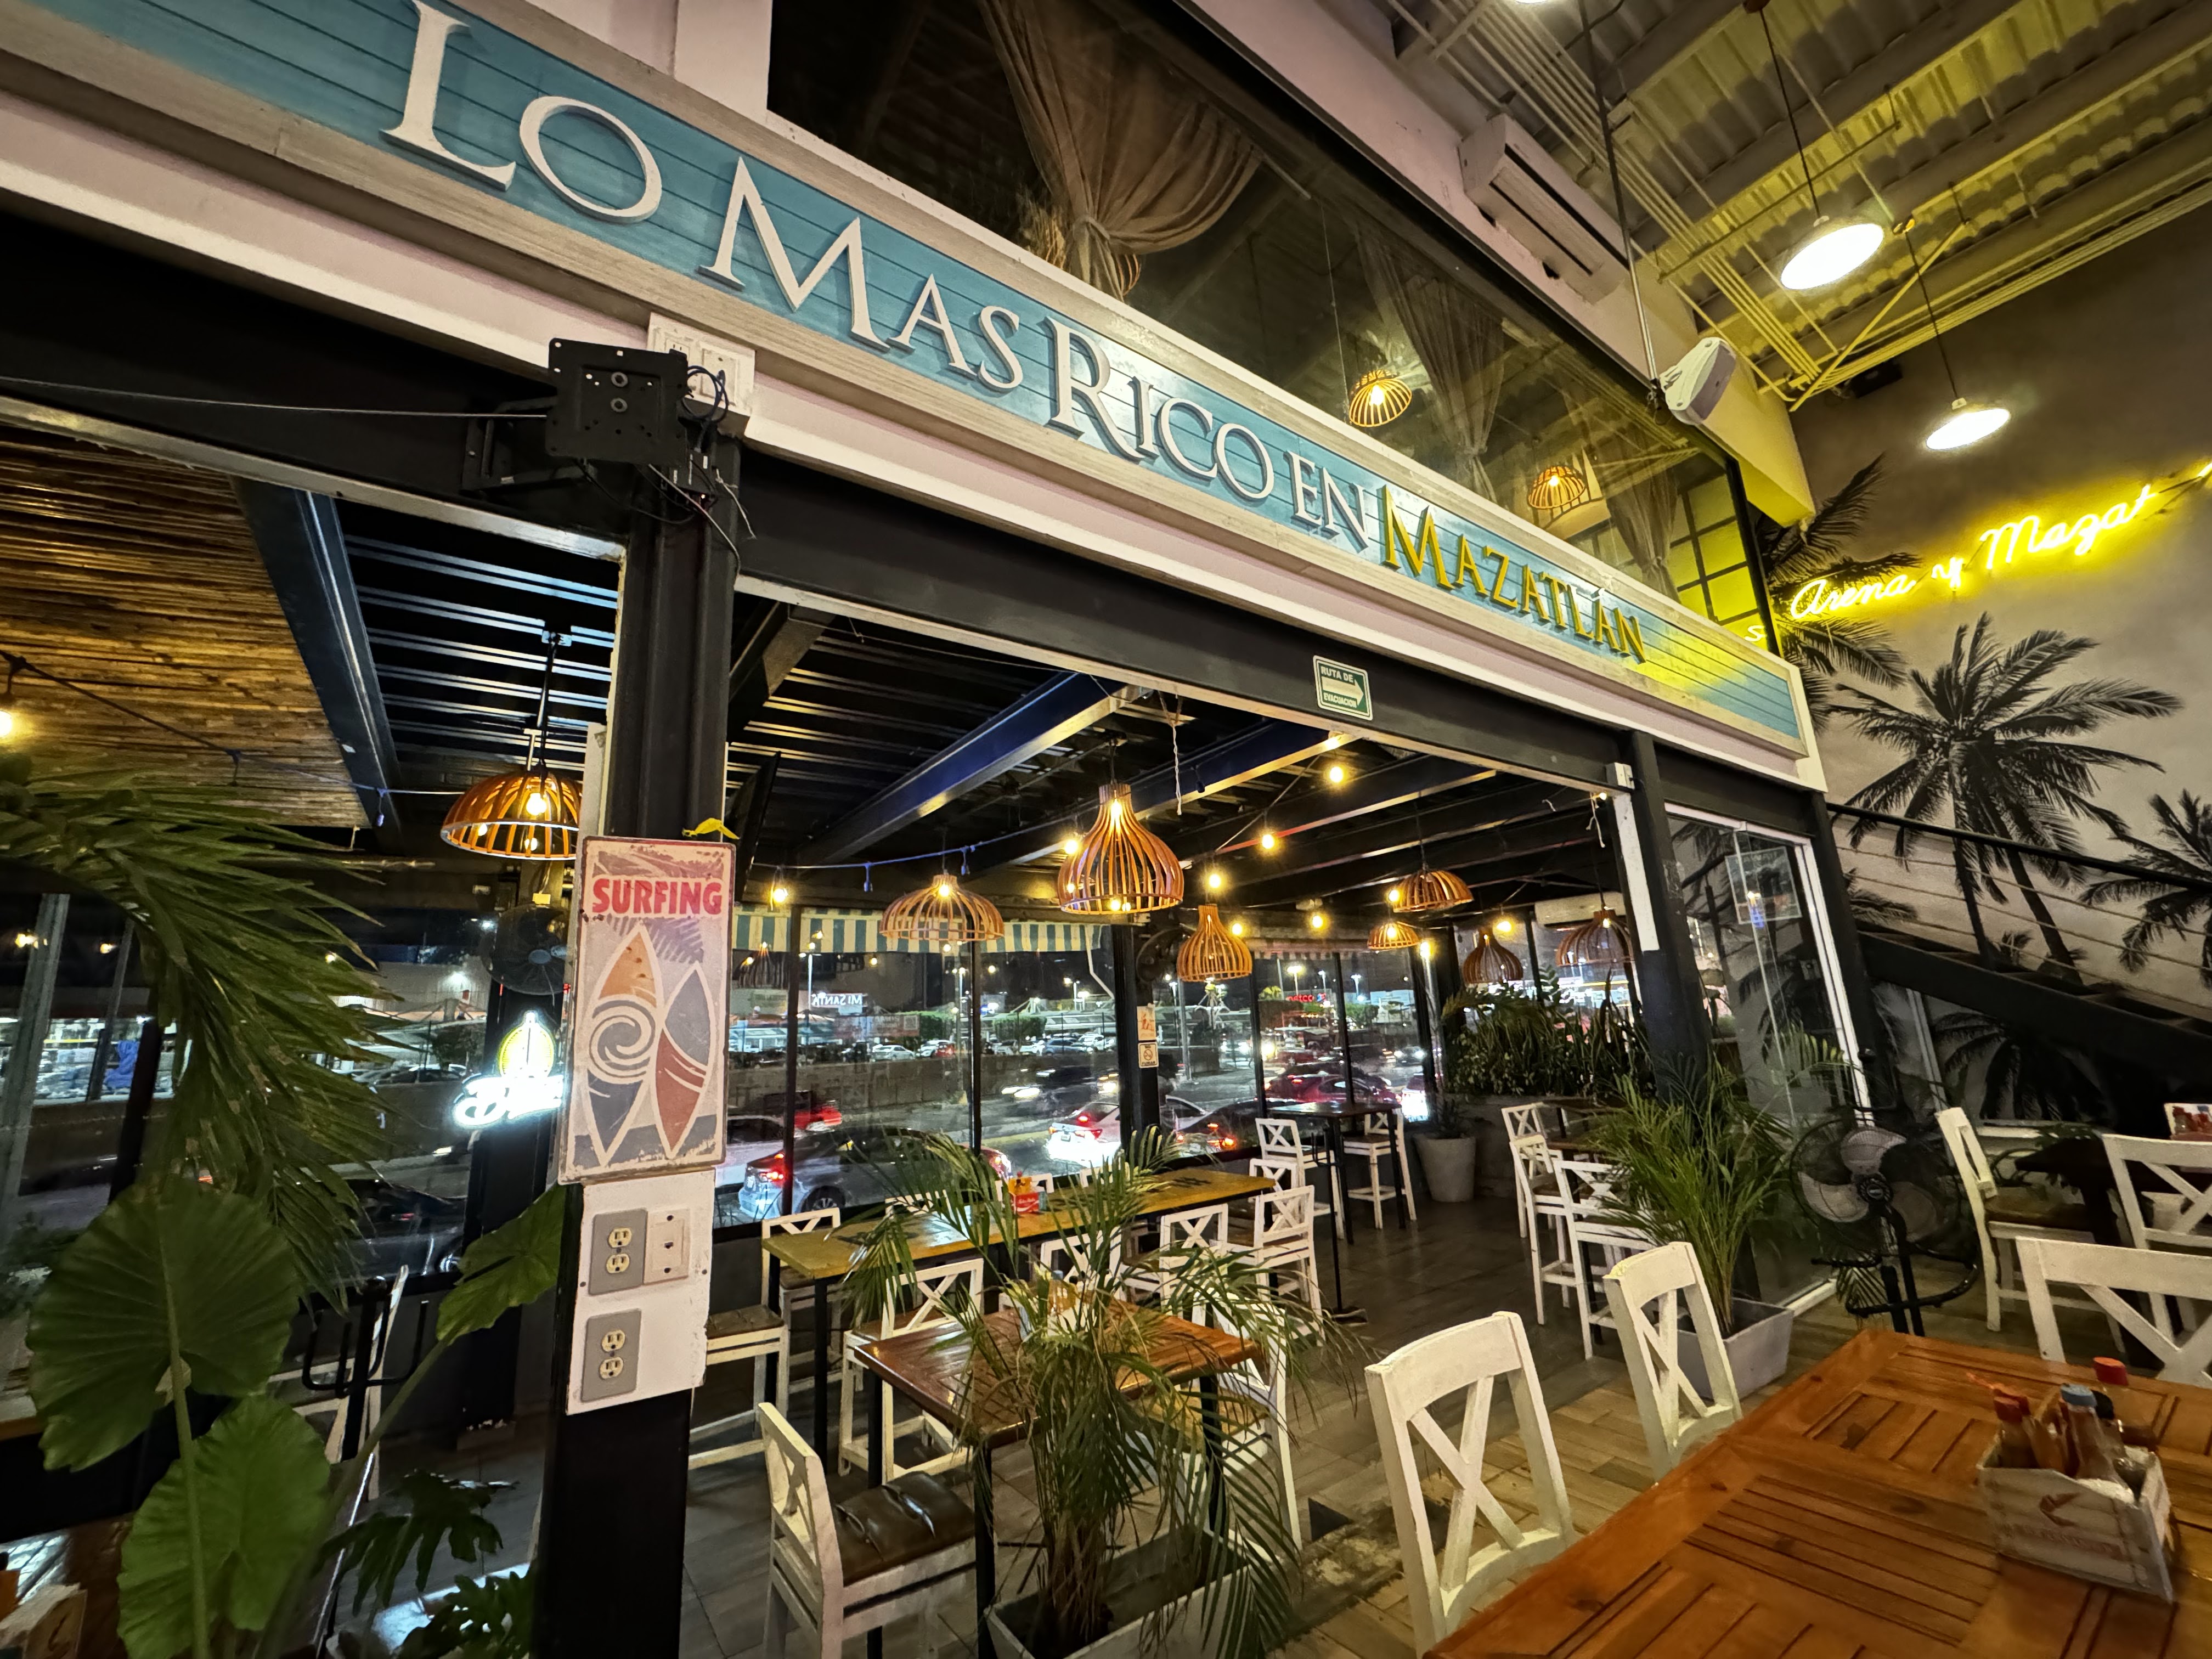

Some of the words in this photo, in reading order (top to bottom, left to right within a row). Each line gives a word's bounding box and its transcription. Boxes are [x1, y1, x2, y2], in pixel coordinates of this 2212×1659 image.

[380, 0, 663, 222] LO
[698, 156, 1024, 393] MAS
[1045, 316, 1274, 500] RICO
[1285, 450, 1369, 552] EN
[1380, 484, 1646, 665] MAZATLÁN
[1790, 574, 1917, 619] Arena
[1931, 556, 1964, 590] y
[1979, 462, 2212, 570] Mazat
[1321, 665, 1342, 680] RUTA
[1343, 672, 1354, 684] DE
[1323, 692, 1358, 709] EVACUACION
[592, 878, 723, 915] SURFING
